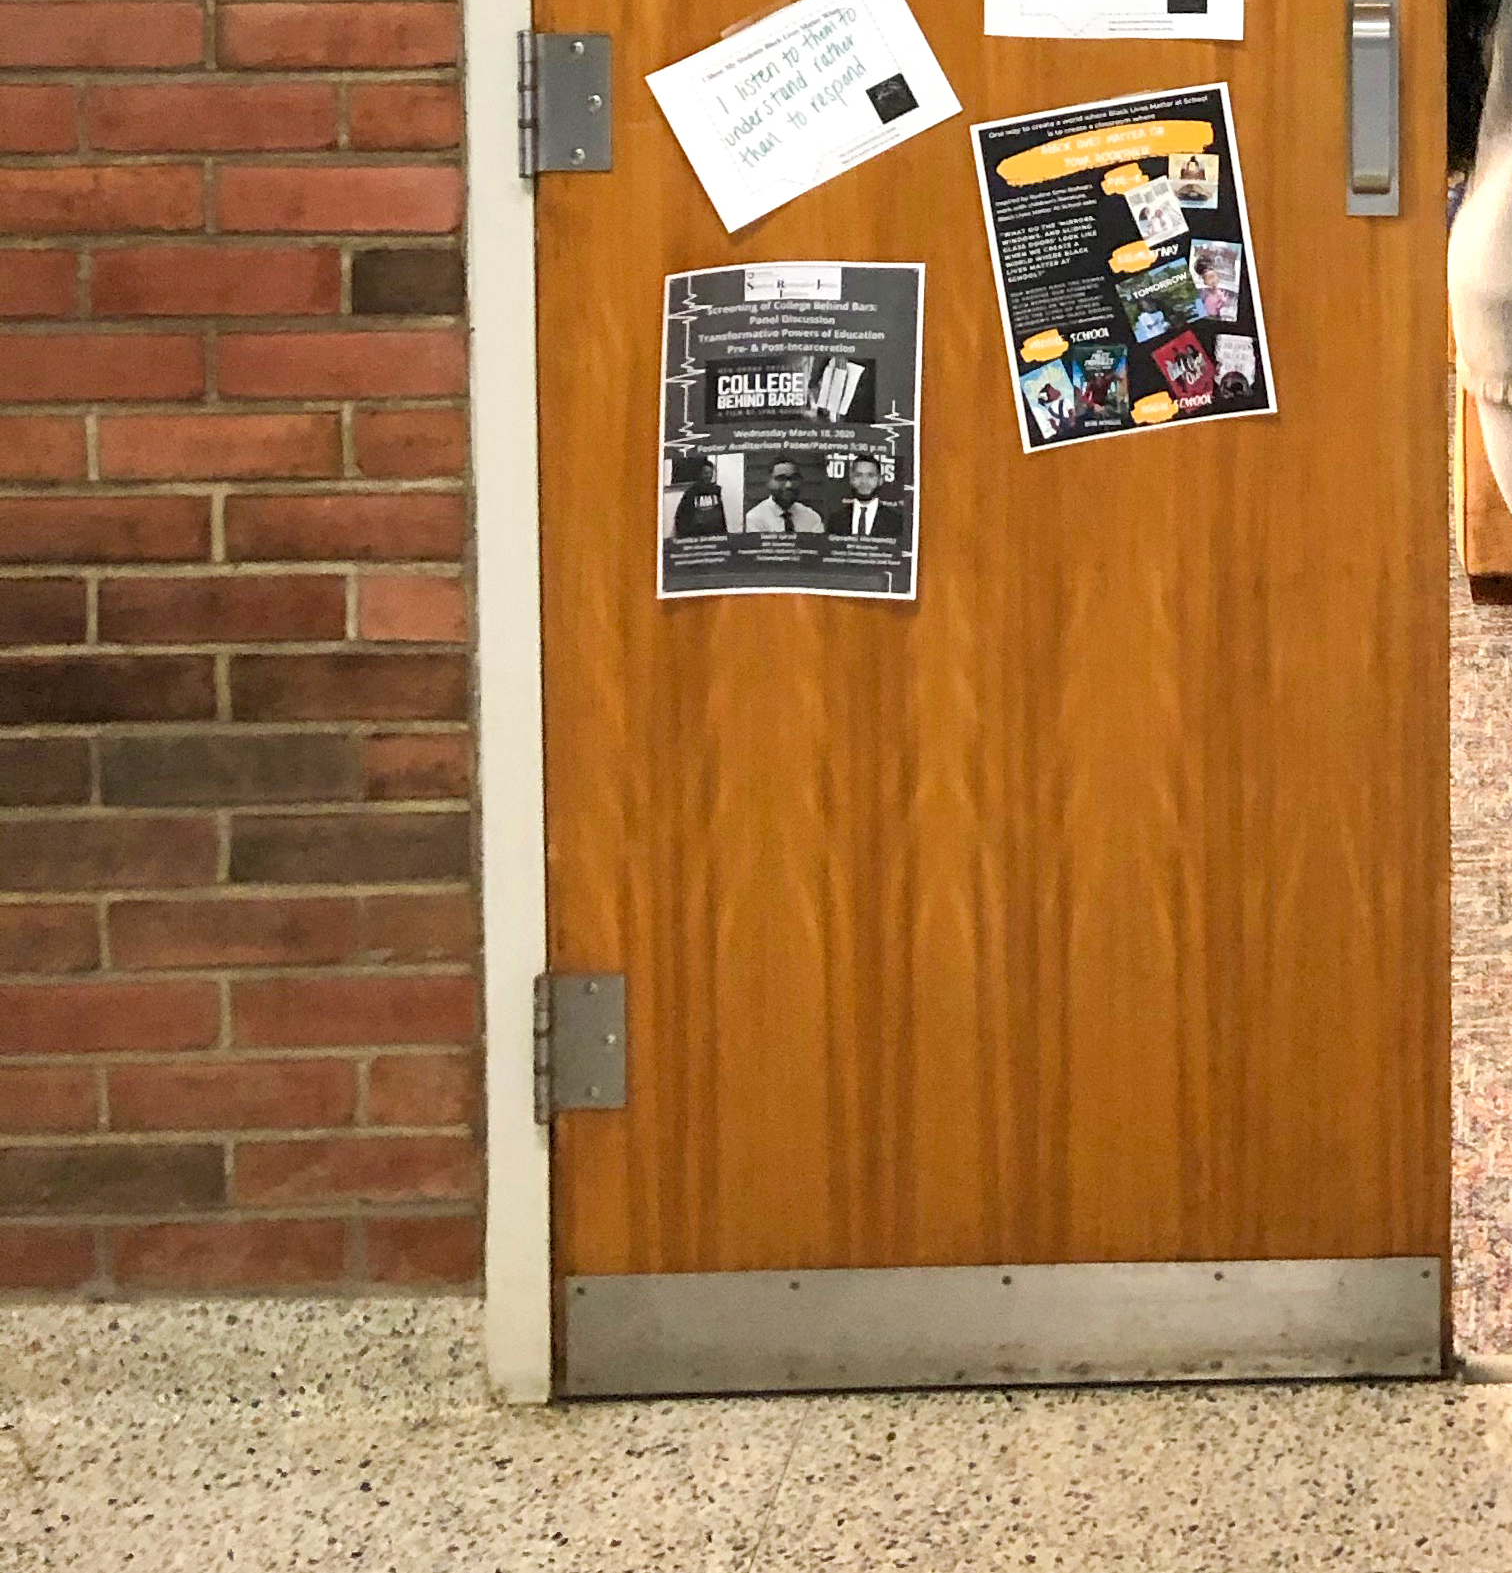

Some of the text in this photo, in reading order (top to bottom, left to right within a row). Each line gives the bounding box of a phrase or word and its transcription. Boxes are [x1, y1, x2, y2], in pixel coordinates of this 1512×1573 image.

[734, 62, 782, 101] listen
[782, 46, 800, 69] to
[802, 22, 838, 50] them
[838, 6, 857, 27] to
[724, 69, 808, 147] understand
[813, 32, 856, 73] rather
[739, 54, 868, 168] than to respond
[1108, 108, 1129, 117] Black
[1150, 101, 1174, 110] Matter
[1183, 95, 1208, 105] School
[1064, 247, 1089, 256] BLACK
[1030, 260, 1059, 270] MATTER
[1132, 272, 1187, 300] TOMORROW
[760, 301, 772, 312] of
[774, 300, 812, 313] College
[814, 301, 850, 312] Behind
[750, 314, 836, 326] Panel Discussion
[698, 328, 885, 343] Transformative Powers of Education
[1070, 327, 1110, 344] SCHOOL
[750, 344, 759, 352] &
[762, 343, 856, 354] Post-Incarceration
[718, 372, 805, 396] COLLEGE
[717, 392, 806, 410] BEHIND BARS
[733, 429, 787, 440] Wednesday
[789, 429, 818, 438] March
[728, 441, 782, 451] Auditorium
